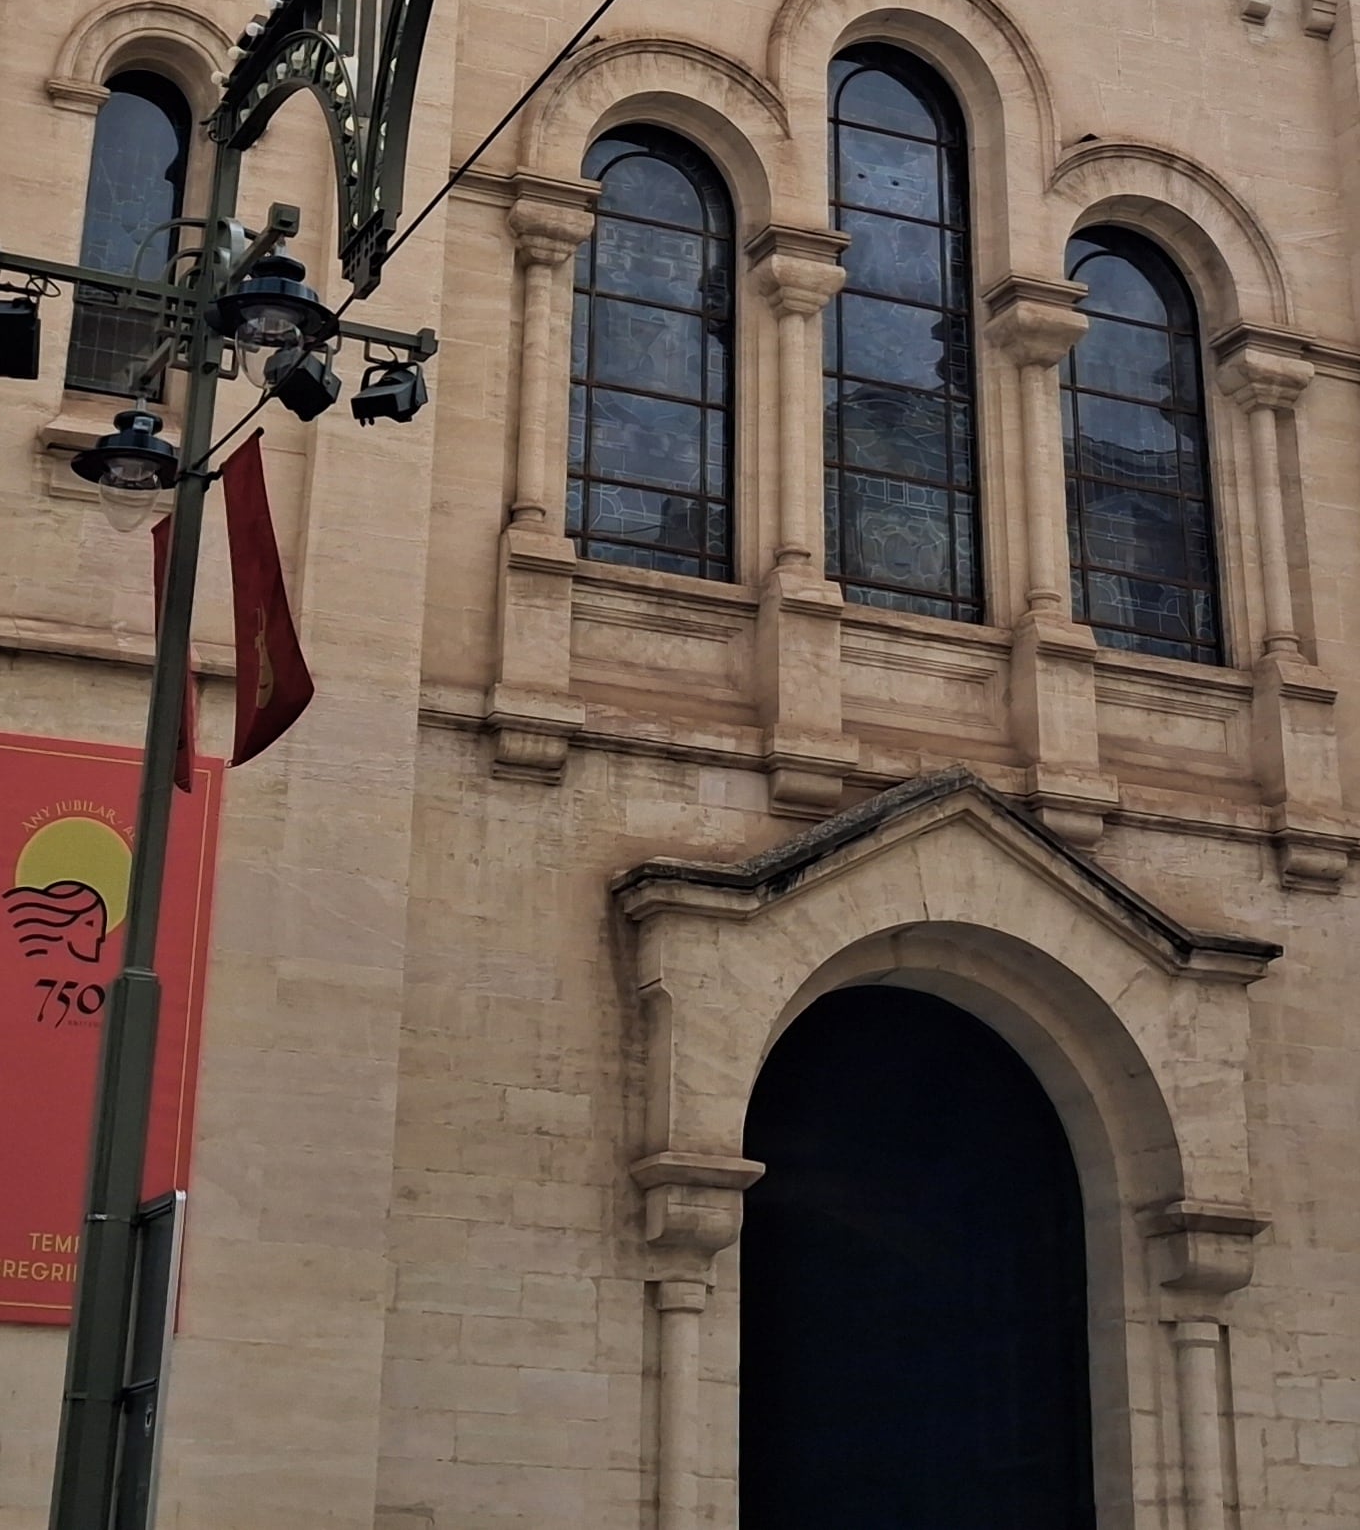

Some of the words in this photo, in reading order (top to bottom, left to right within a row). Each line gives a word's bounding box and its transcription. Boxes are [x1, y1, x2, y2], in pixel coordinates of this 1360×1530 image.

[21, 806, 50, 832] ANY
[56, 799, 117, 825] JUBILAR
[34, 978, 106, 1028] 750
